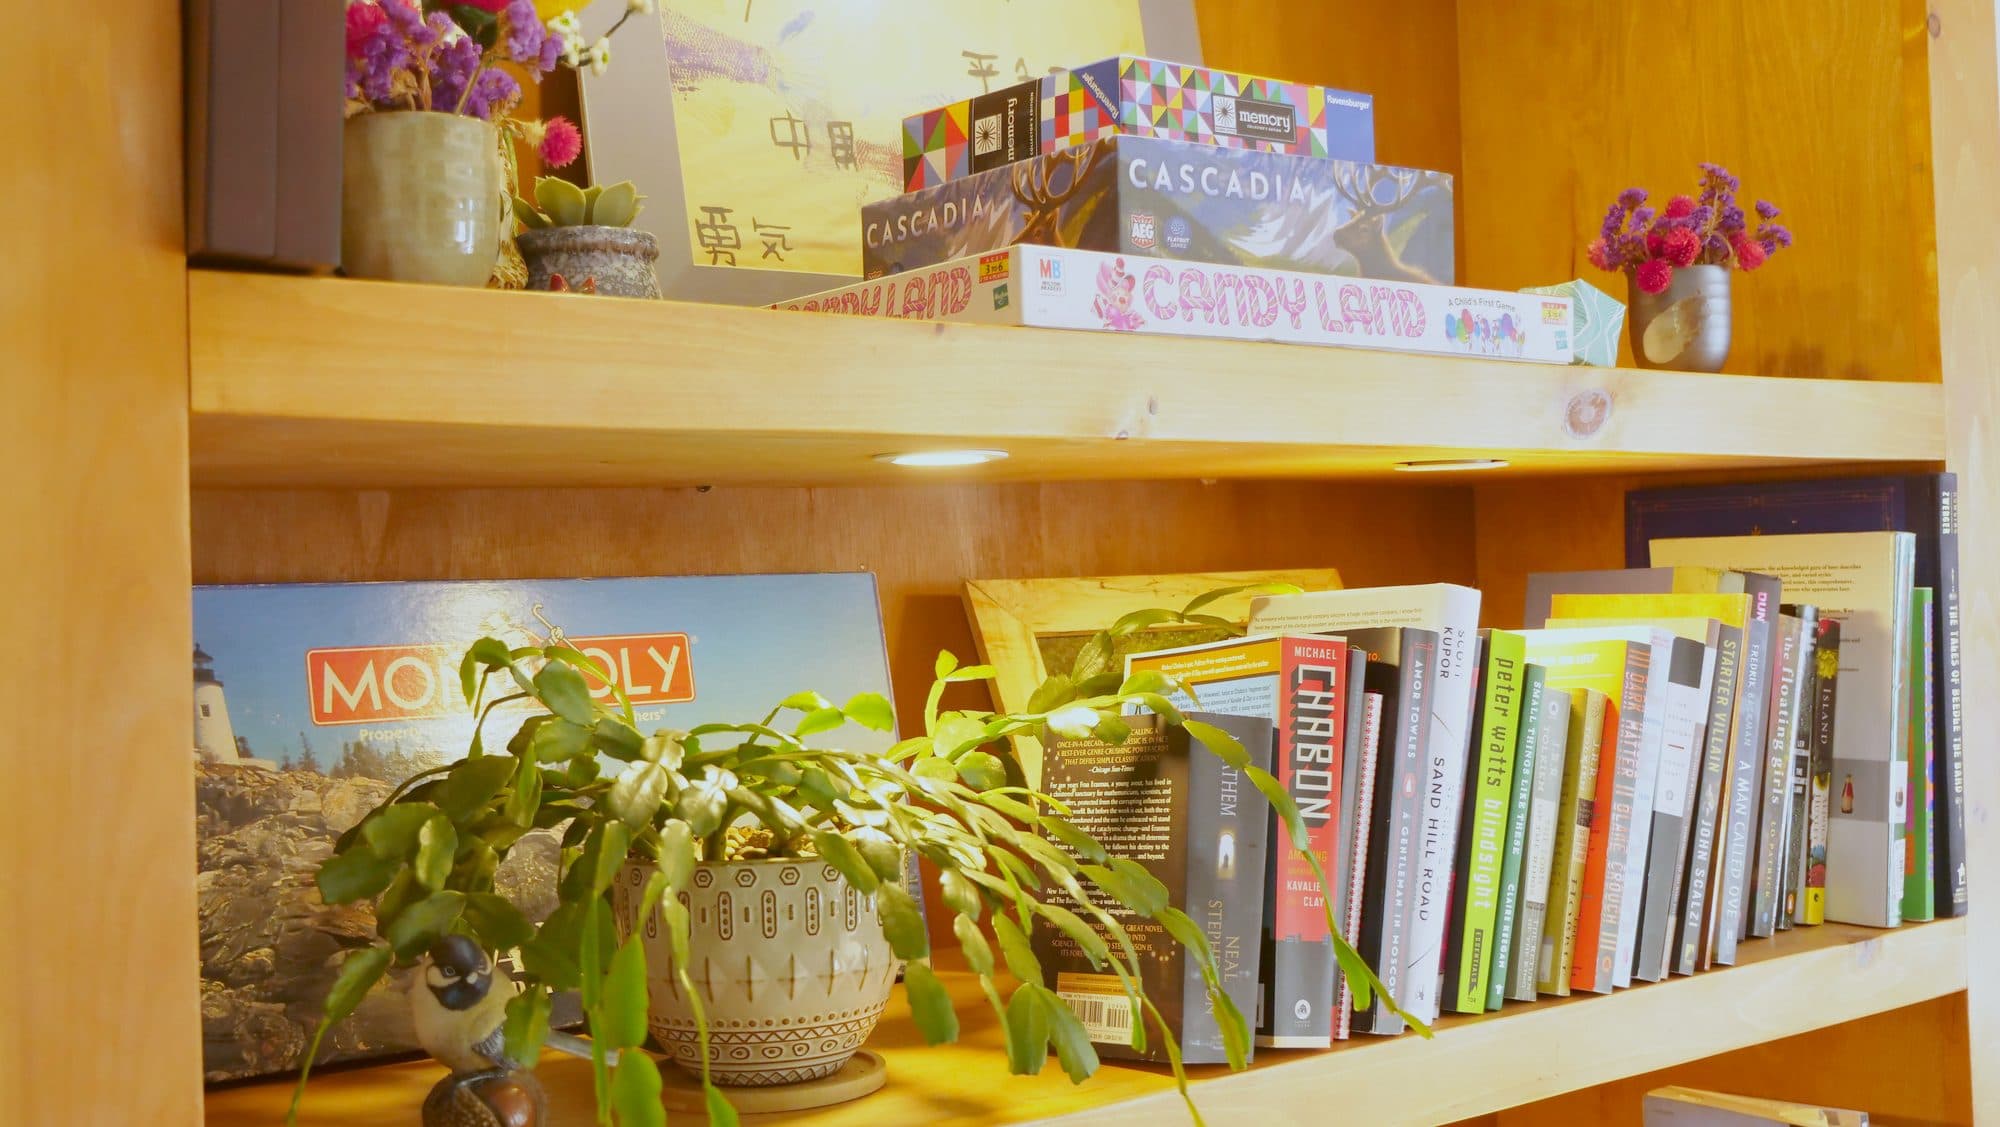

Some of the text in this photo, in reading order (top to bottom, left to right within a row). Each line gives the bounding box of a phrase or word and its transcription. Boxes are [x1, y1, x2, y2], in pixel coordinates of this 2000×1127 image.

[1082, 72, 1120, 120] Ravensburger
[1239, 110, 1290, 133] memory
[1327, 94, 1371, 111] Ravensburger
[1008, 98, 1018, 161] memory
[1129, 158, 1305, 203] CASCADIA
[866, 194, 983, 249] CASCADIA
[1132, 222, 1154, 239] AEG
[1040, 258, 1060, 279] MB
[1143, 264, 1426, 338] CANDY LAND
[1454, 297, 1477, 306] Child's
[1495, 300, 1516, 312] Game
[1949, 605, 1958, 626] THE
[1294, 646, 1337, 660] MICHAEL
[1440, 627, 1454, 679] KUPOR
[1951, 669, 1960, 685] OF
[1407, 659, 1424, 759] AMOR TOWLES
[1487, 656, 1515, 788] peter watts
[1616, 671, 1648, 778] DARK MATTER
[1706, 639, 1736, 774] STARTER VILLAIN
[1771, 637, 1794, 804] the floating girls
[1821, 688, 1832, 745] ISLAND
[1065, 757, 1078, 766] THAT
[1079, 757, 1095, 765] DEFIES
[1096, 756, 1114, 764] SIMPLE
[1295, 664, 1336, 820] CHABON
[1511, 680, 1543, 856] SMALL THINGS LIKE THESE
[1394, 825, 1409, 908] GENTLEMAN
[1419, 756, 1445, 921] SAND HILL ROAD
[1473, 797, 1503, 909] blindsight
[1726, 760, 1751, 919] A MAN CALLED OVE
[1303, 896, 1325, 907] CLAY
[1604, 862, 1626, 925] CROUCH
[1689, 819, 1712, 928] JOHN SCALZI
[1126, 924, 1164, 932] GREAT NOVEL
[1392, 914, 1402, 928] IN
[1498, 883, 1515, 968] CLAIRE KEEGAN
[1224, 935, 1241, 983] NEAL
